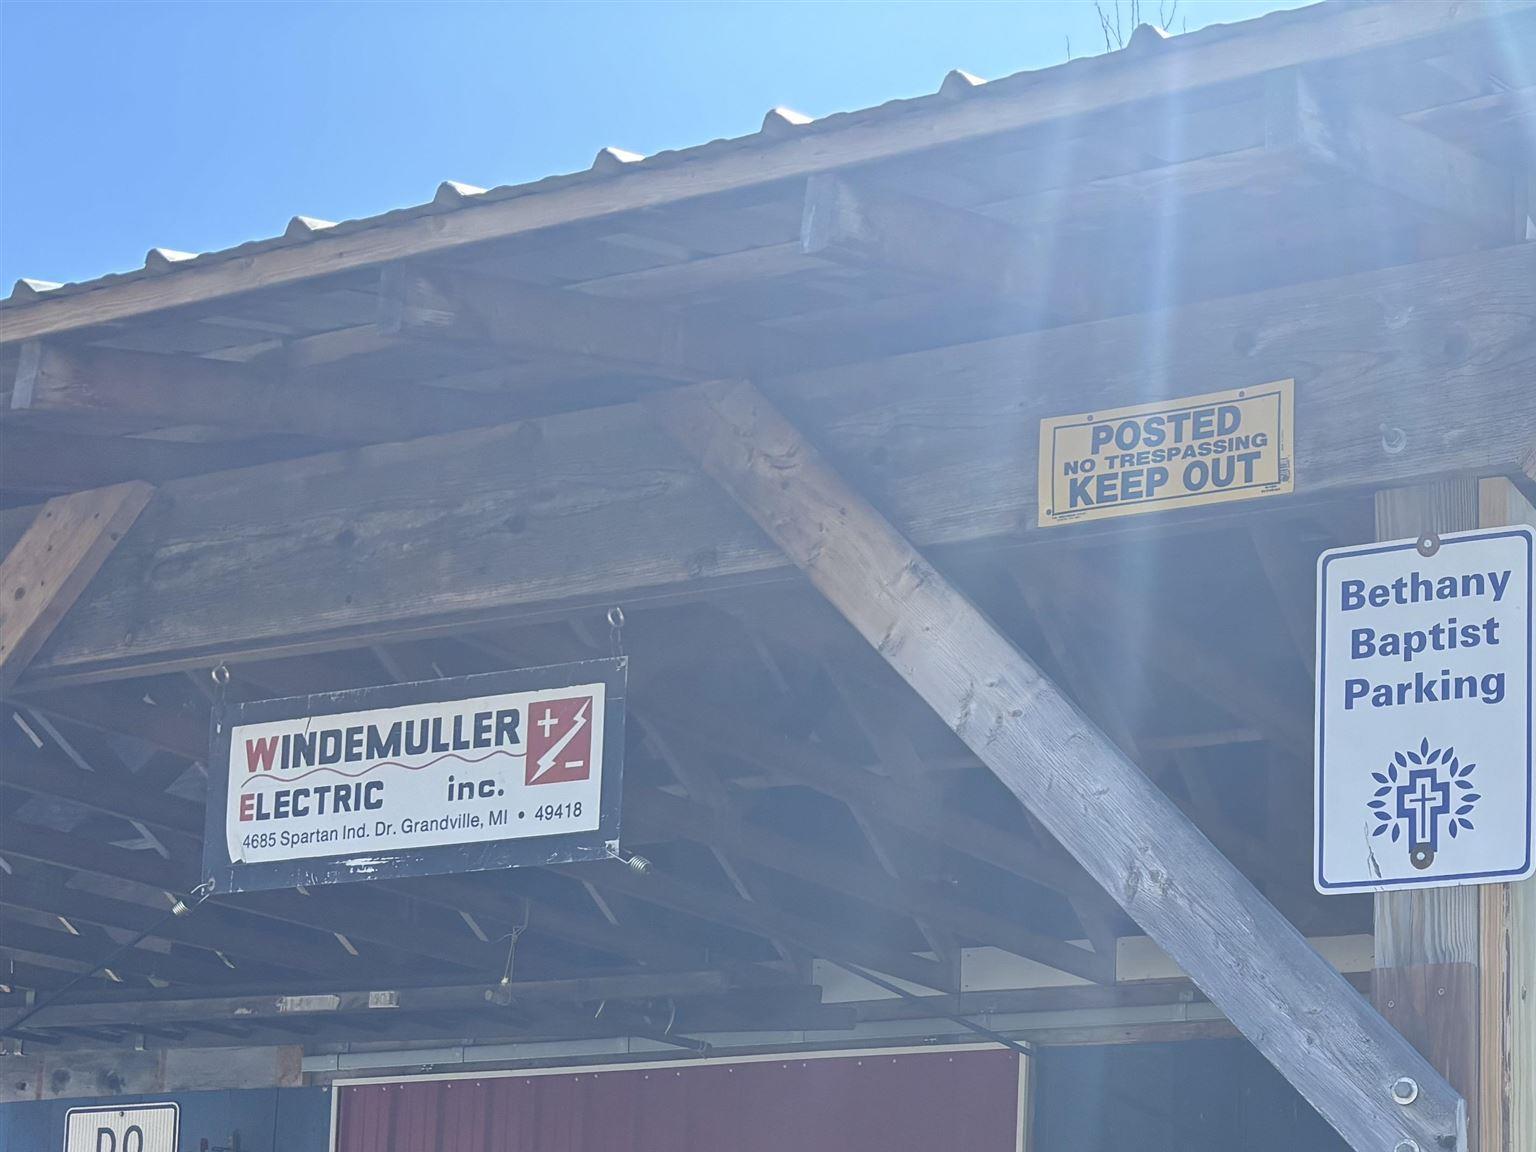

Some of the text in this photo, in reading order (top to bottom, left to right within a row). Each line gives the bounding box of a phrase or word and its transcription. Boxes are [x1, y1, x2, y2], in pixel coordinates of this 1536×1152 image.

[1091, 405, 1241, 455] POSTED
[1063, 458, 1096, 476] NO
[1104, 432, 1268, 470] TRESPASSING
[1069, 466, 1169, 508] KEEP
[1182, 451, 1261, 492] OUT
[1341, 570, 1512, 612] Bethany
[1351, 616, 1500, 662] Baptist
[1344, 669, 1506, 710] Parking
[246, 708, 520, 773] WINDEMULLER
[240, 775, 504, 822] ELECTRIC inc.
[242, 800, 583, 850] 4685 Spartan Ind. Dr. Grandville, MI 49418
